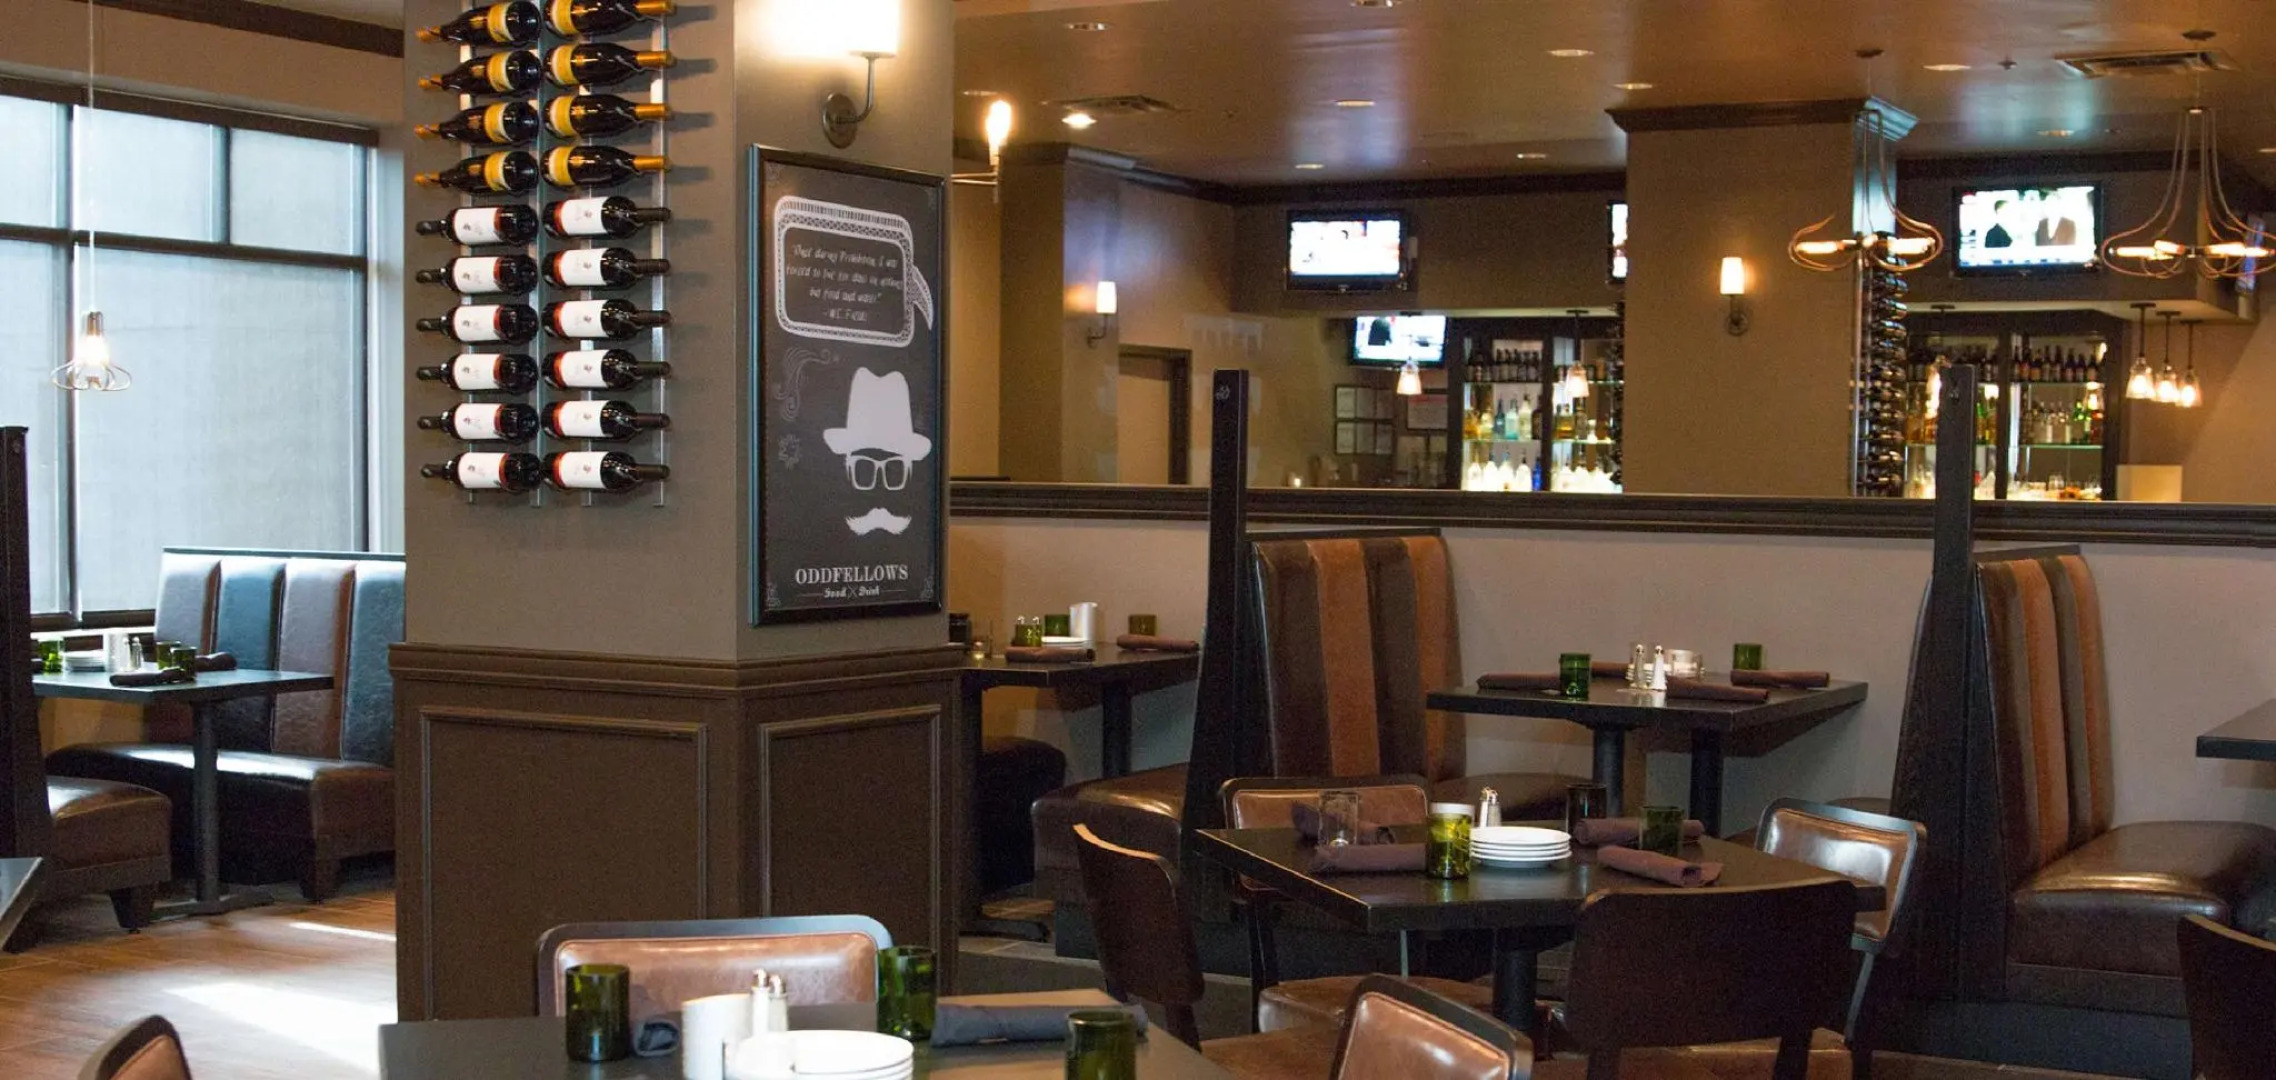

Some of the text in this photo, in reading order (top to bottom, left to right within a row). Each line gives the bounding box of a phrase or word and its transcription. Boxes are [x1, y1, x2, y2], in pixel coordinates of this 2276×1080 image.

[786, 265, 811, 276] forced
[813, 267, 821, 278] to
[795, 563, 909, 584] ODDFELLOWS
[823, 585, 880, 598] Food Drink
